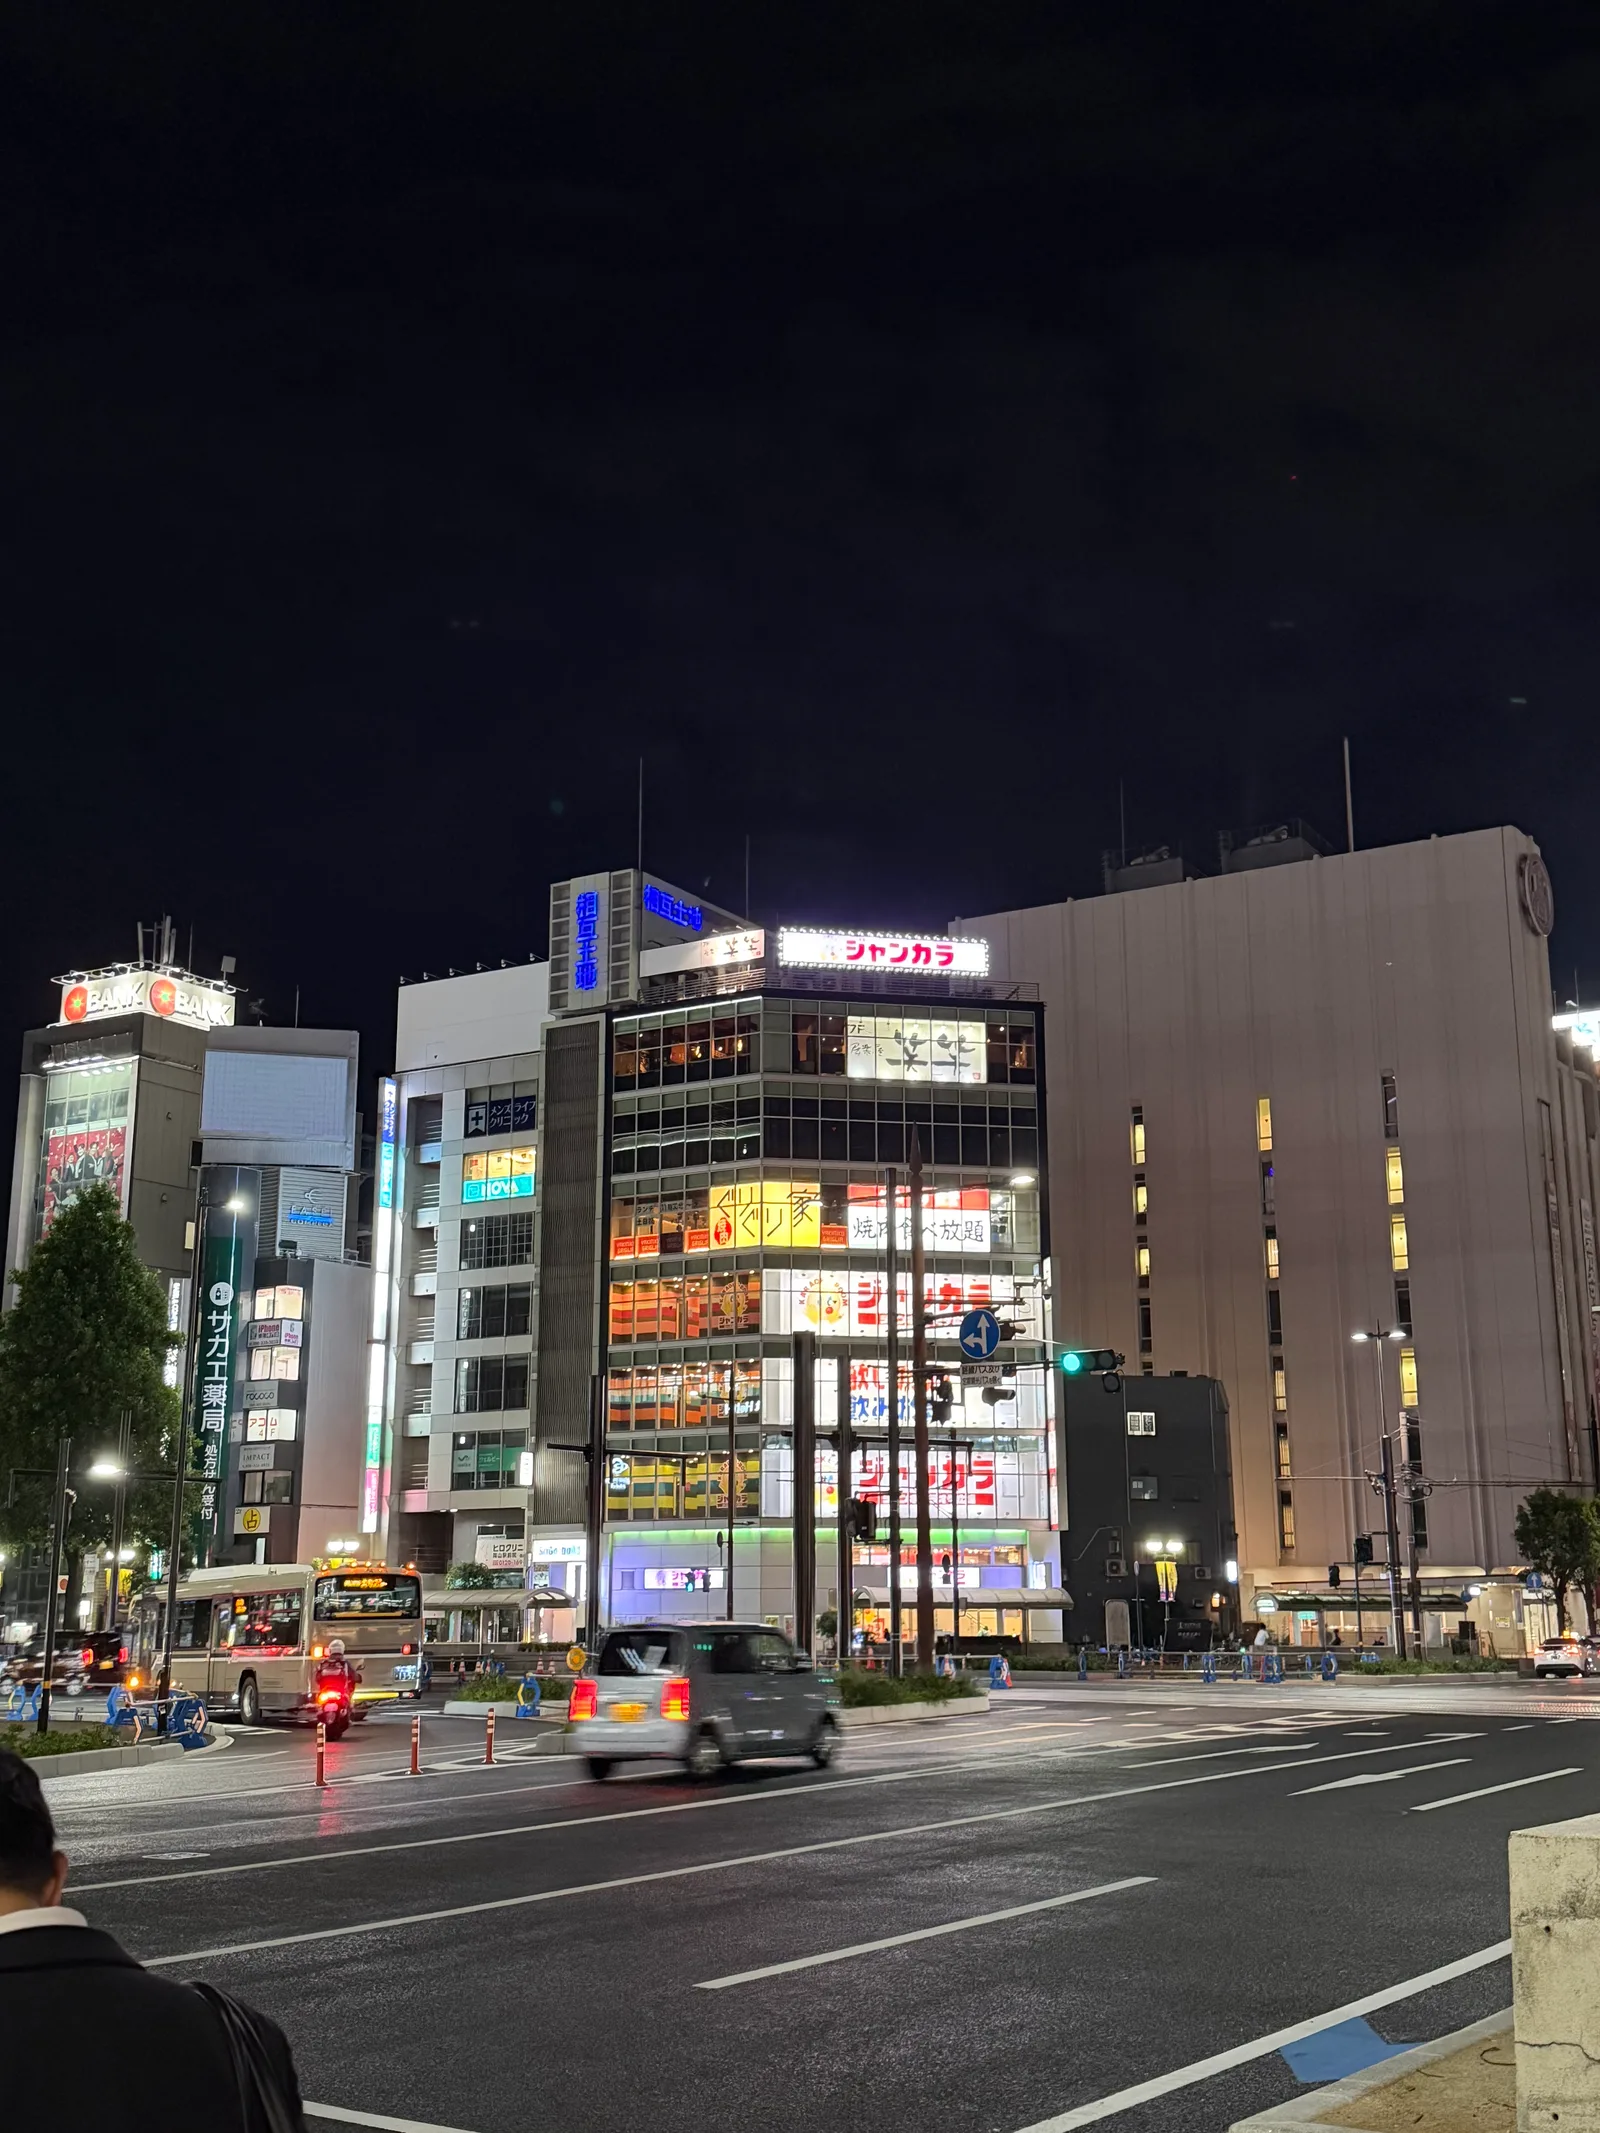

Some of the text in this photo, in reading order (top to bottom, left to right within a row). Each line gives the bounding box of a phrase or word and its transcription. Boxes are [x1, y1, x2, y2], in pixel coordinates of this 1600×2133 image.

[643, 884, 703, 932] 相互土地
[575, 891, 598, 990] 相互土地
[846, 937, 954, 966] ジャンカラ
[87, 981, 144, 1009] BANK
[173, 994, 232, 1026] BANK
[848, 1023, 864, 1034] 7F
[490, 1100, 536, 1116] メンズライフ
[489, 1113, 529, 1128] クリニック
[481, 1180, 519, 1197] NOVA
[259, 1323, 280, 1333] iPhone
[201, 1310, 233, 1433] サカエ薬局
[249, 1417, 278, 1428] アコム
[200, 1444, 218, 1520] 処方せん受付
[246, 1509, 258, 1530] 占
